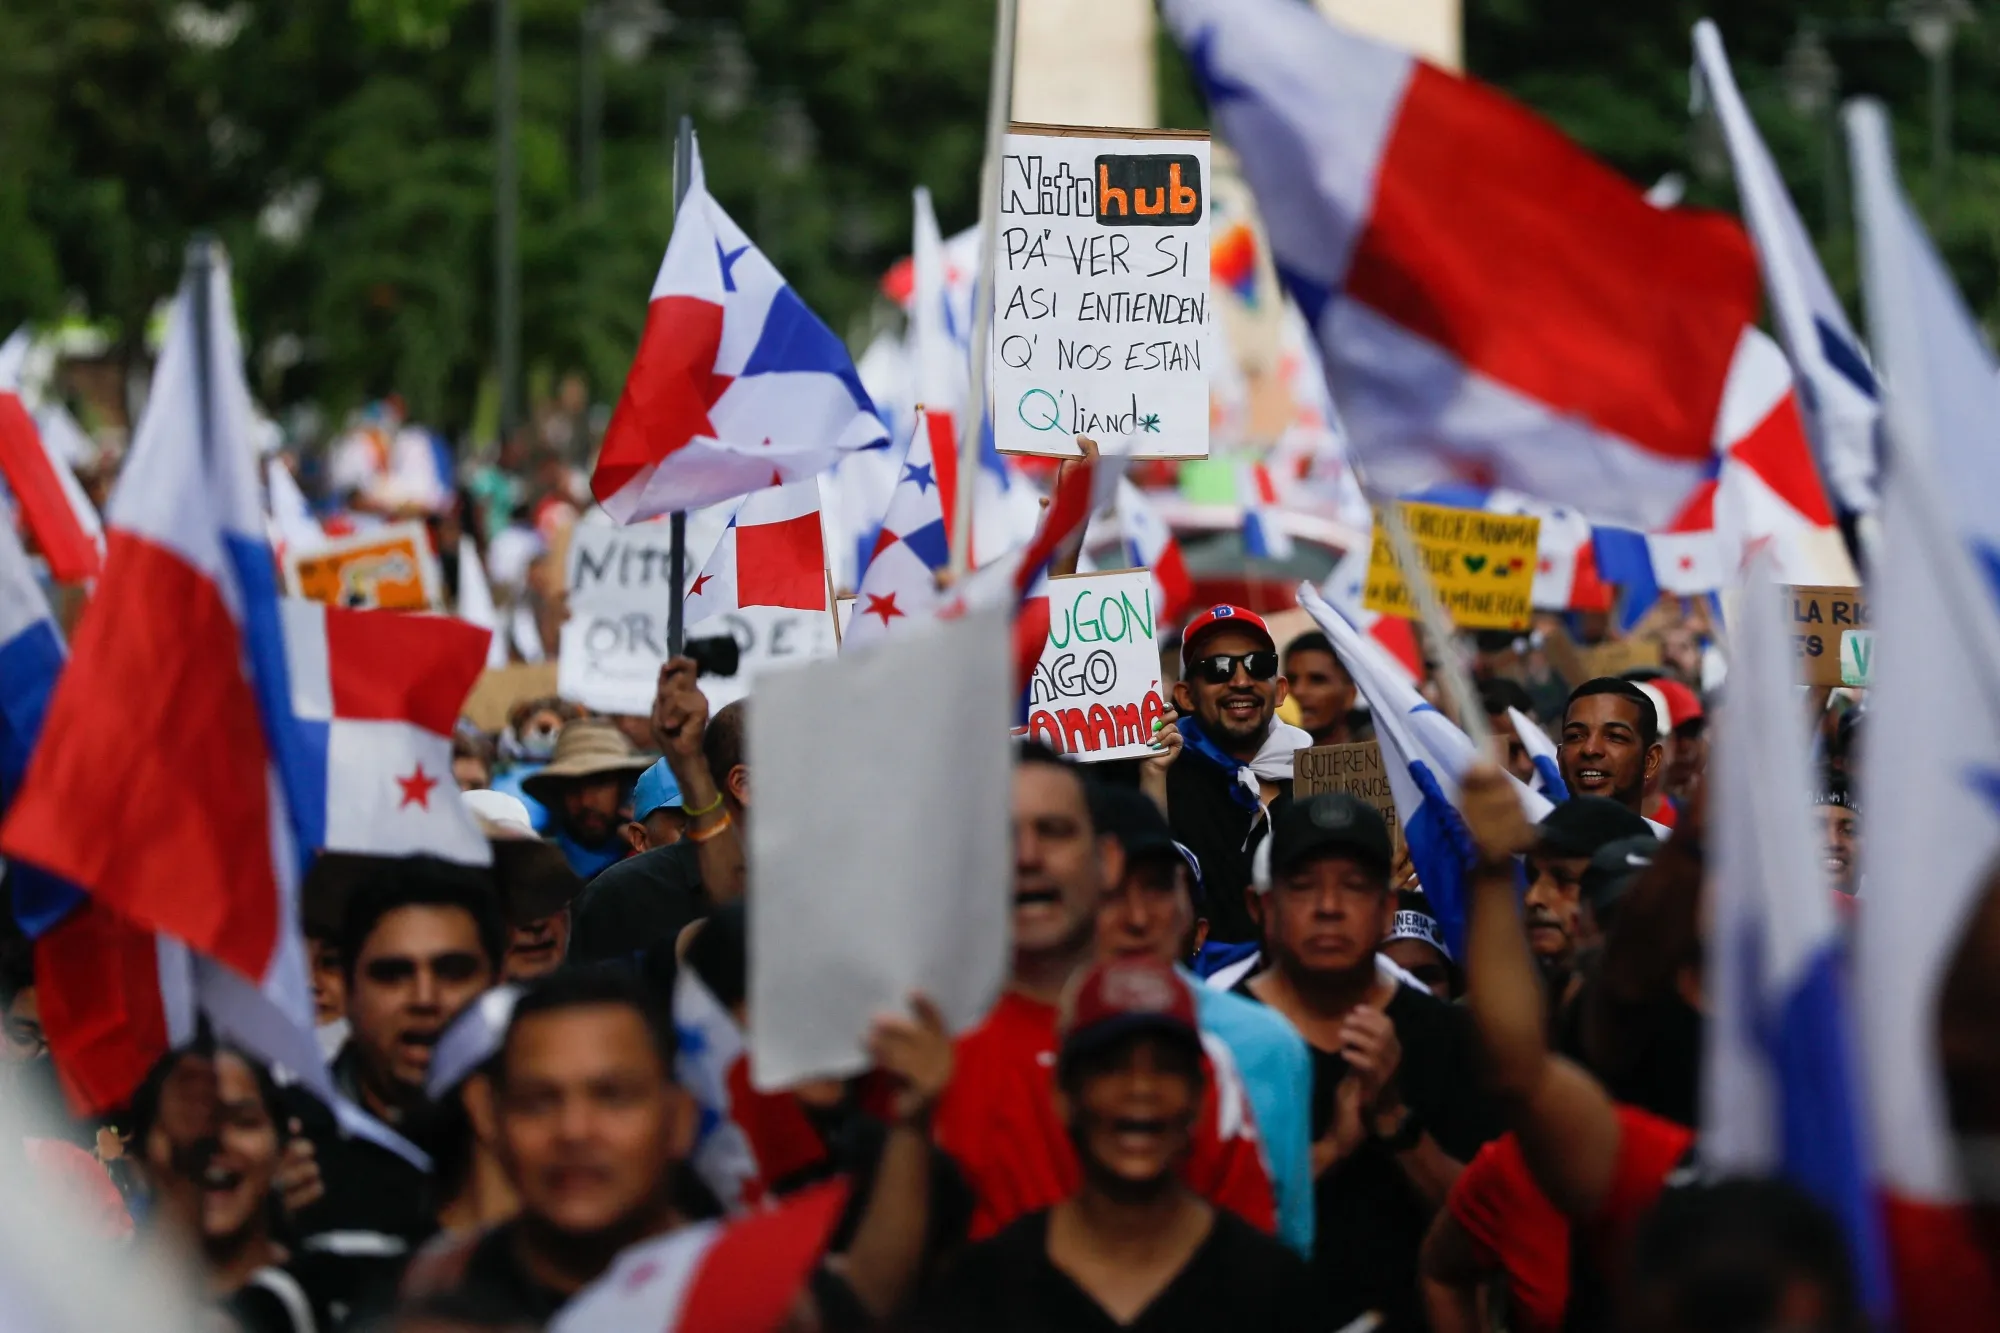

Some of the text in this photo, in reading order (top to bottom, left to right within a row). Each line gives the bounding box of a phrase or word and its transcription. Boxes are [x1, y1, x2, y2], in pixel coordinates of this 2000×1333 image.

[1066, 233, 1130, 277] VER
[1147, 235, 1189, 277] SI
[1004, 285, 1205, 325] ASI ENTIENDEN
[1001, 333, 1201, 371] Q' NOS ESTAN
[1049, 588, 1153, 649] UGON
[1793, 599, 1823, 624] LA
[1030, 649, 1117, 706] AGO
[1029, 680, 1164, 756] ANAMÁ
[1300, 749, 1378, 781] QUIEREN
